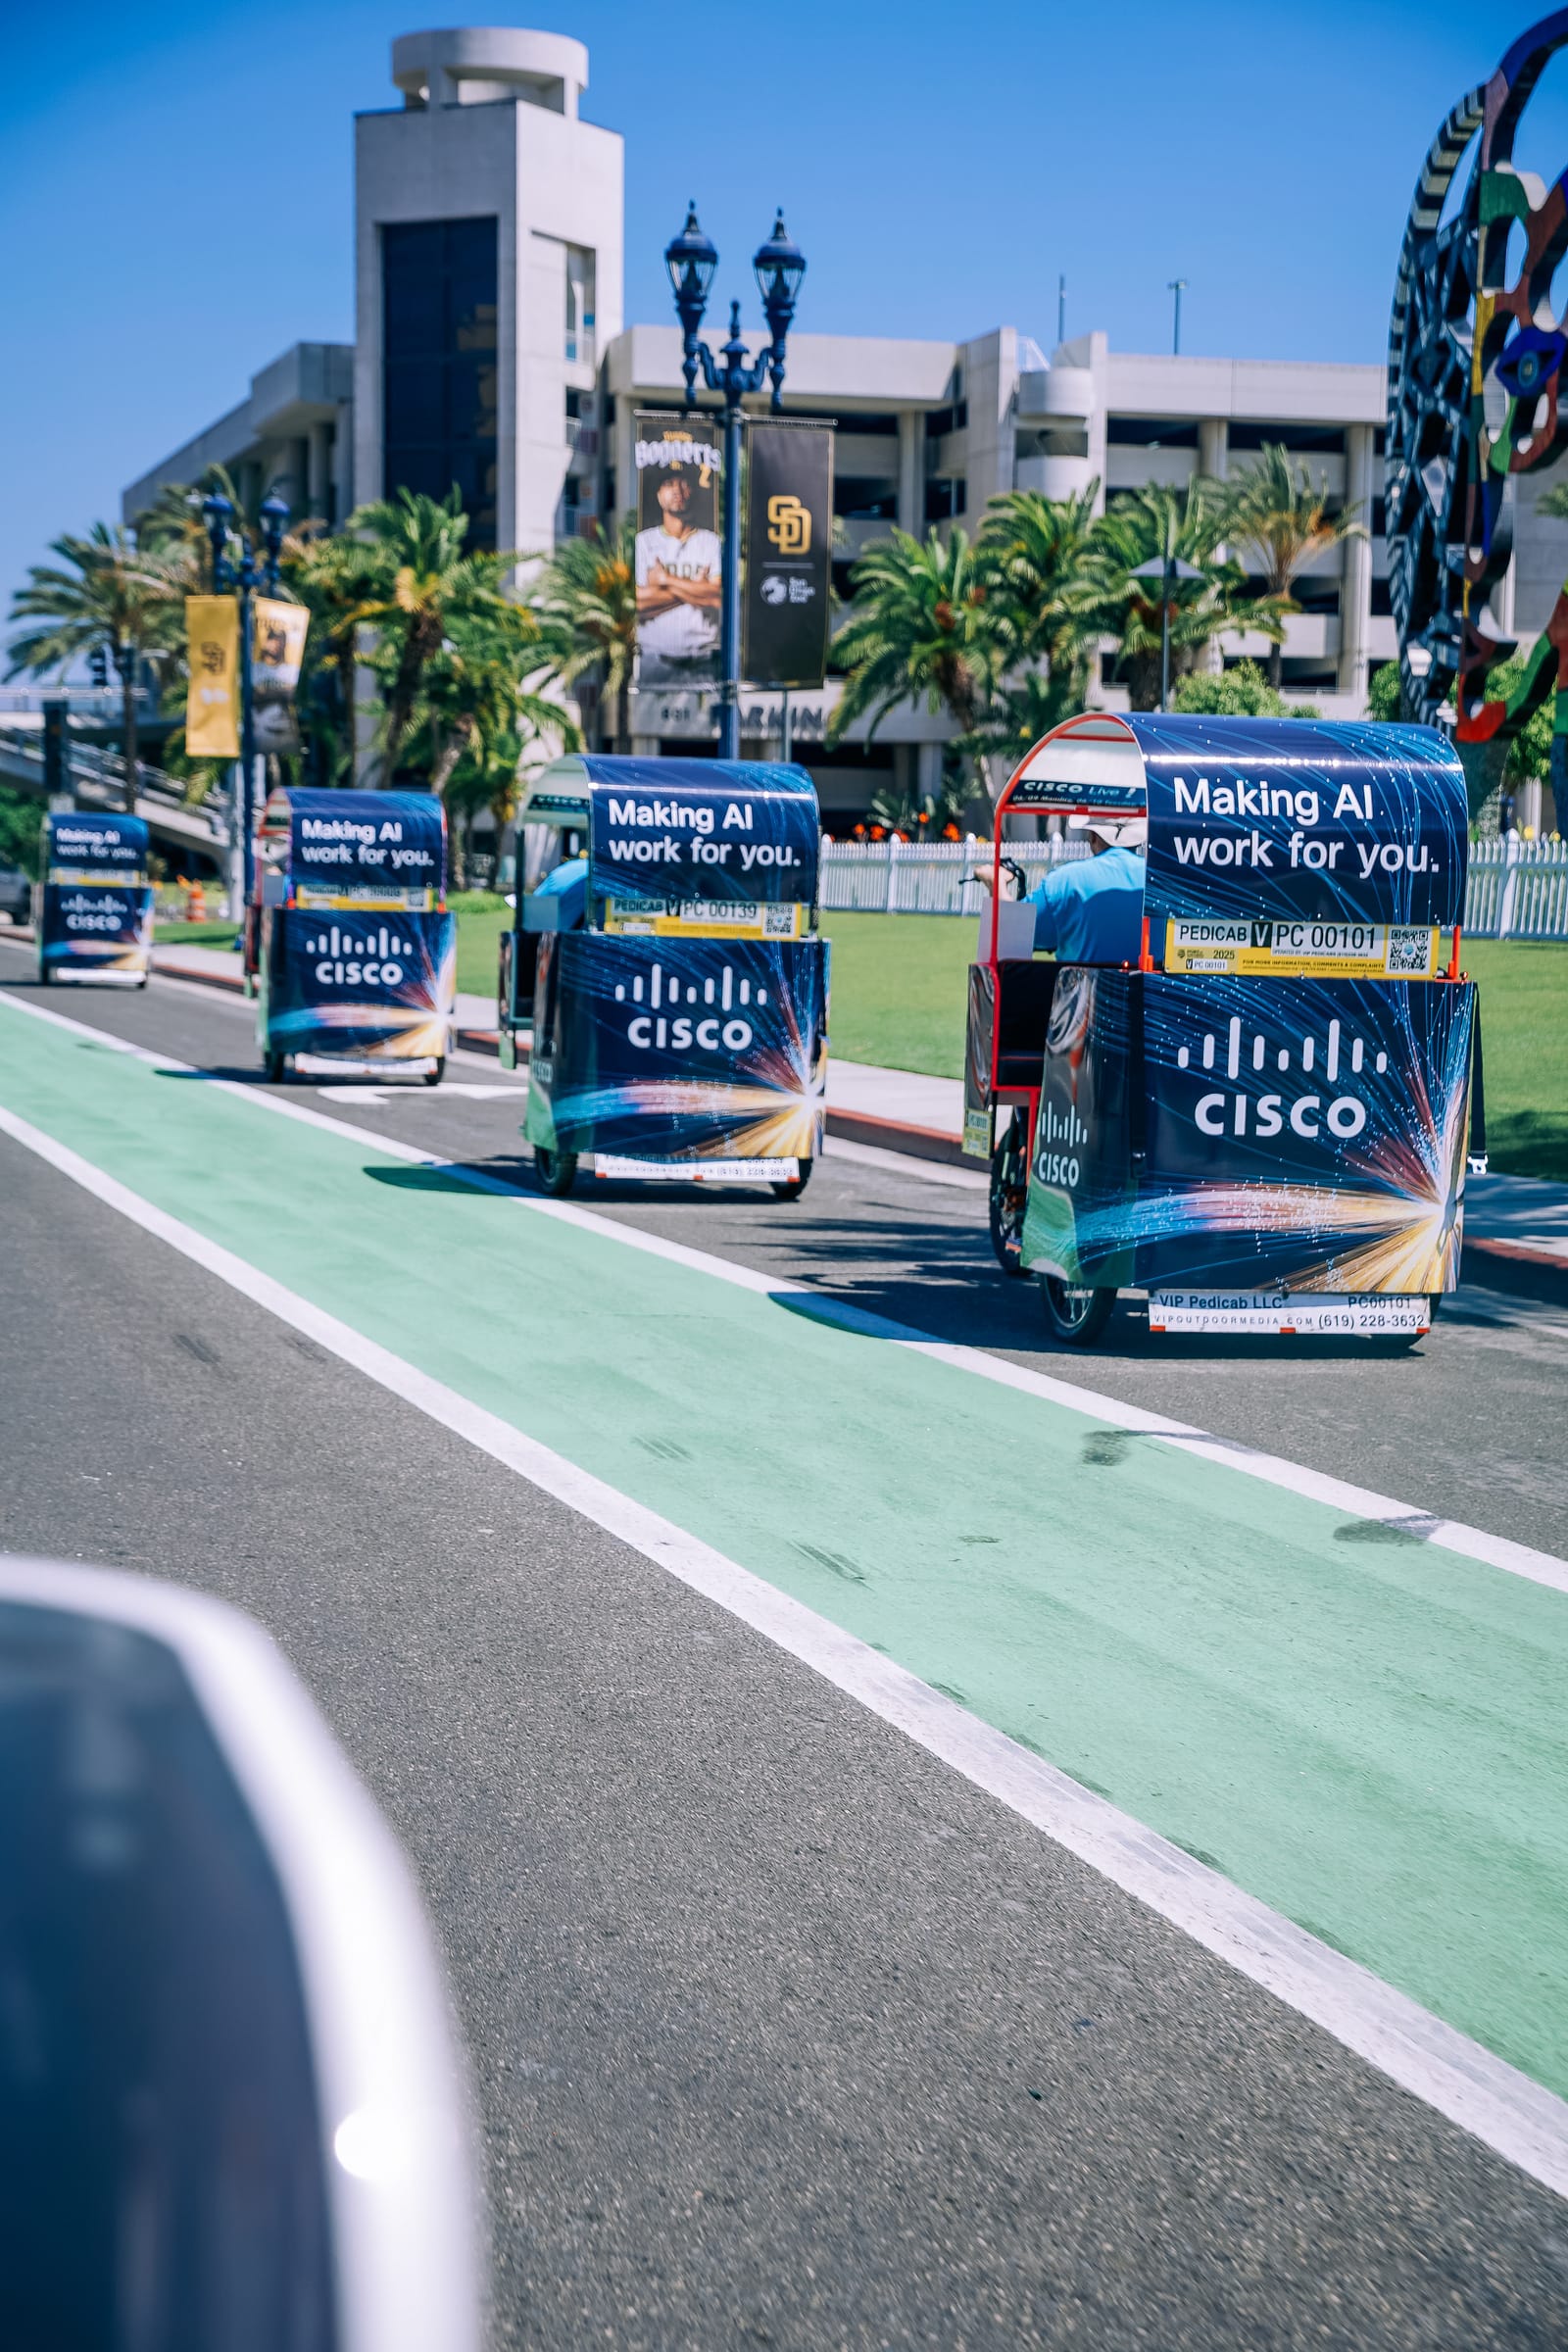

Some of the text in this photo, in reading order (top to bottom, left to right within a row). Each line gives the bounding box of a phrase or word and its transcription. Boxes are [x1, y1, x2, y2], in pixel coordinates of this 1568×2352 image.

[1024, 782, 1083, 794] CISCO
[1173, 777, 1373, 826] Making AI
[609, 798, 754, 833] Making AI
[301, 818, 403, 845] Making AI
[301, 844, 435, 869] work for you.
[609, 836, 802, 871] work for you.
[1174, 830, 1440, 879] work for you.
[613, 900, 663, 911] PEDICAB
[684, 900, 704, 916] PC
[710, 901, 757, 919] 00139
[1180, 925, 1248, 942] PEDICAB
[1276, 924, 1303, 948] PC
[1311, 926, 1374, 950] 00101
[1213, 950, 1235, 959] 2025
[315, 960, 404, 986] CISCO
[627, 1017, 753, 1052] CISCO
[1194, 1093, 1367, 1139] CISCO
[1038, 1152, 1079, 1188] CISCO
[1159, 1295, 1410, 1309] VIP Pedicab LLC PC00101
[1318, 1314, 1354, 1329] (619)
[1359, 1314, 1425, 1328] 228-3632
